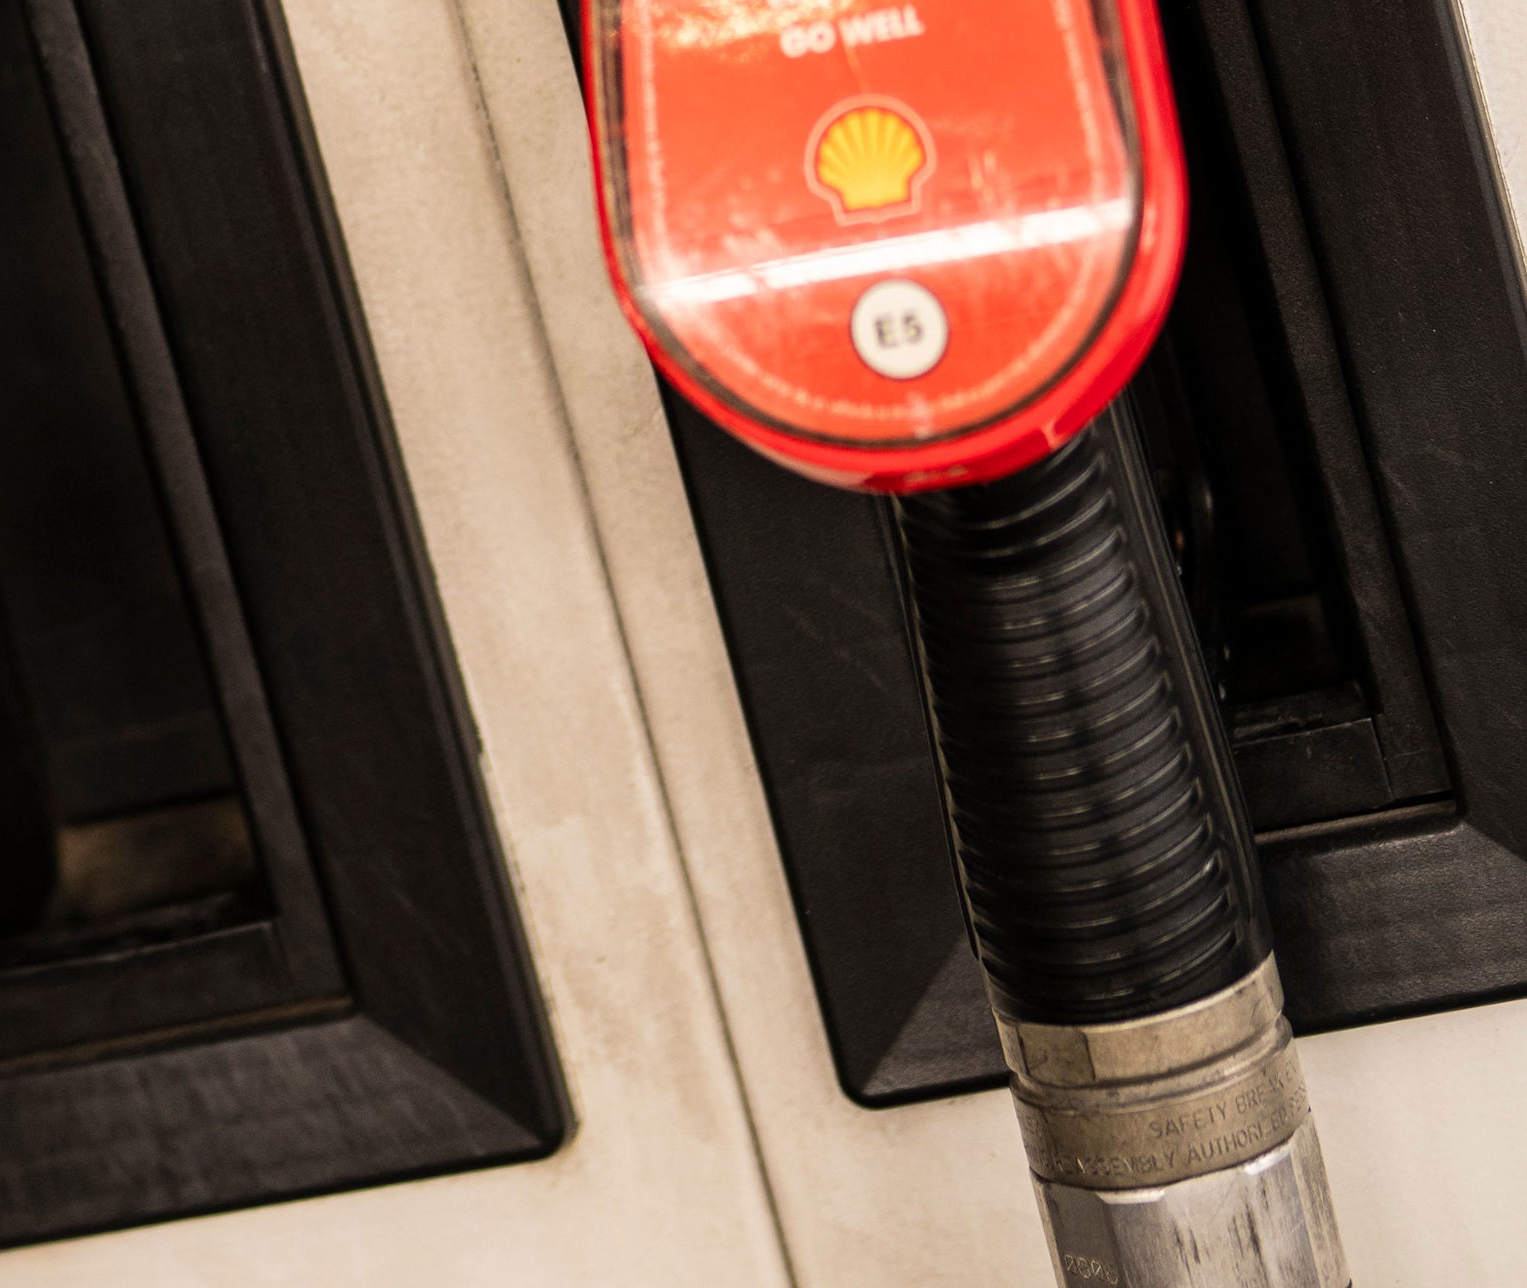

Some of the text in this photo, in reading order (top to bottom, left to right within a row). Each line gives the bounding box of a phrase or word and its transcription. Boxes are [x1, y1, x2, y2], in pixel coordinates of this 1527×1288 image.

[838, 3, 925, 48] WELL
[874, 316, 923, 349] E5
[1149, 1102, 1227, 1139] SAFETY
[1187, 1105, 1288, 1165] AUTHORIED
